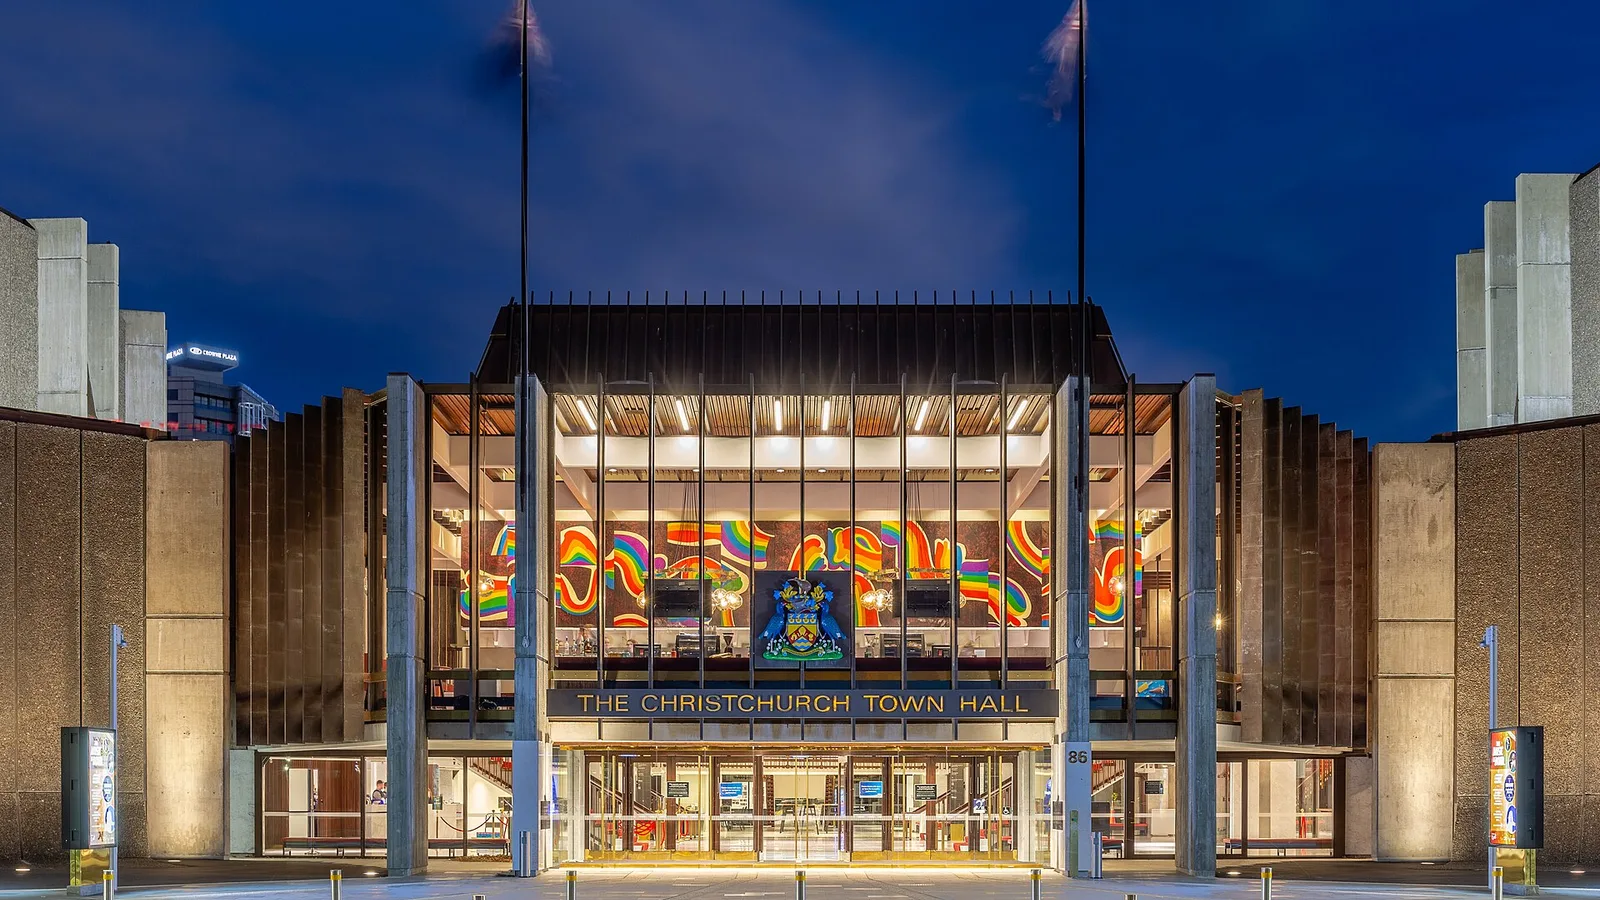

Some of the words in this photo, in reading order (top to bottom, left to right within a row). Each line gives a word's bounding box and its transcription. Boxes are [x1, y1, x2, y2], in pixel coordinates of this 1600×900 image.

[222, 353, 237, 361] PLAZA
[578, 694, 628, 713] THE
[643, 694, 851, 713] CHRISTCHURCH
[864, 694, 945, 713] TOWN
[959, 694, 1029, 713] HALL
[1067, 750, 1088, 764] 86
